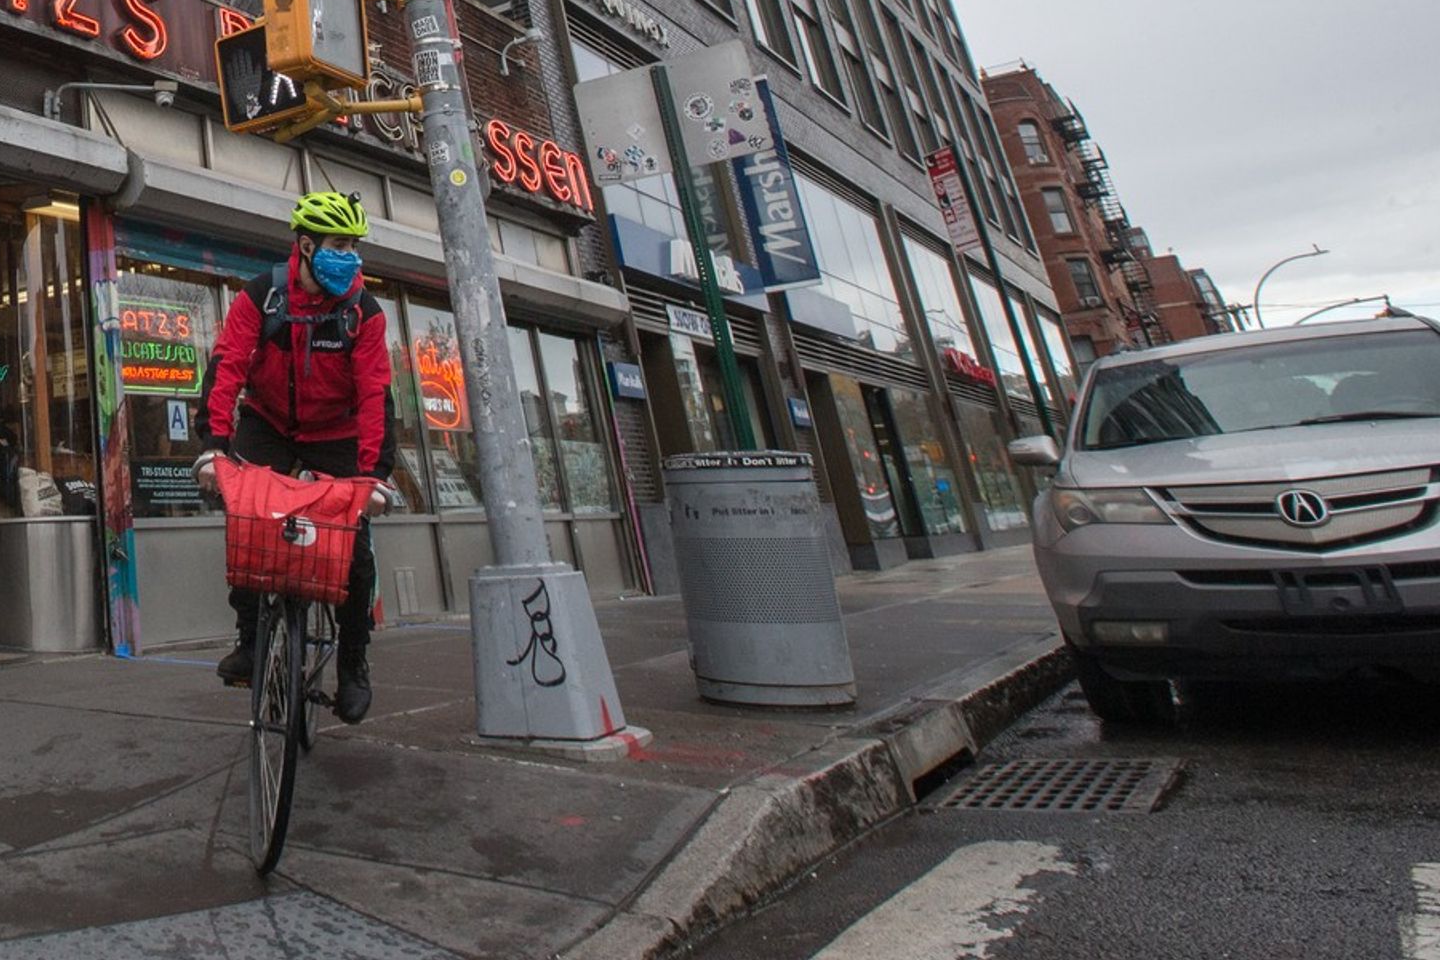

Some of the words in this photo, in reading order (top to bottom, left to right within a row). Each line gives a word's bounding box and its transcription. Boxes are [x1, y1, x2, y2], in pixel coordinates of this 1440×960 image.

[743, 147, 806, 265] Marsh
[122, 310, 189, 338] ATZS
[171, 405, 185, 430] A
[742, 457, 773, 467] Don't
